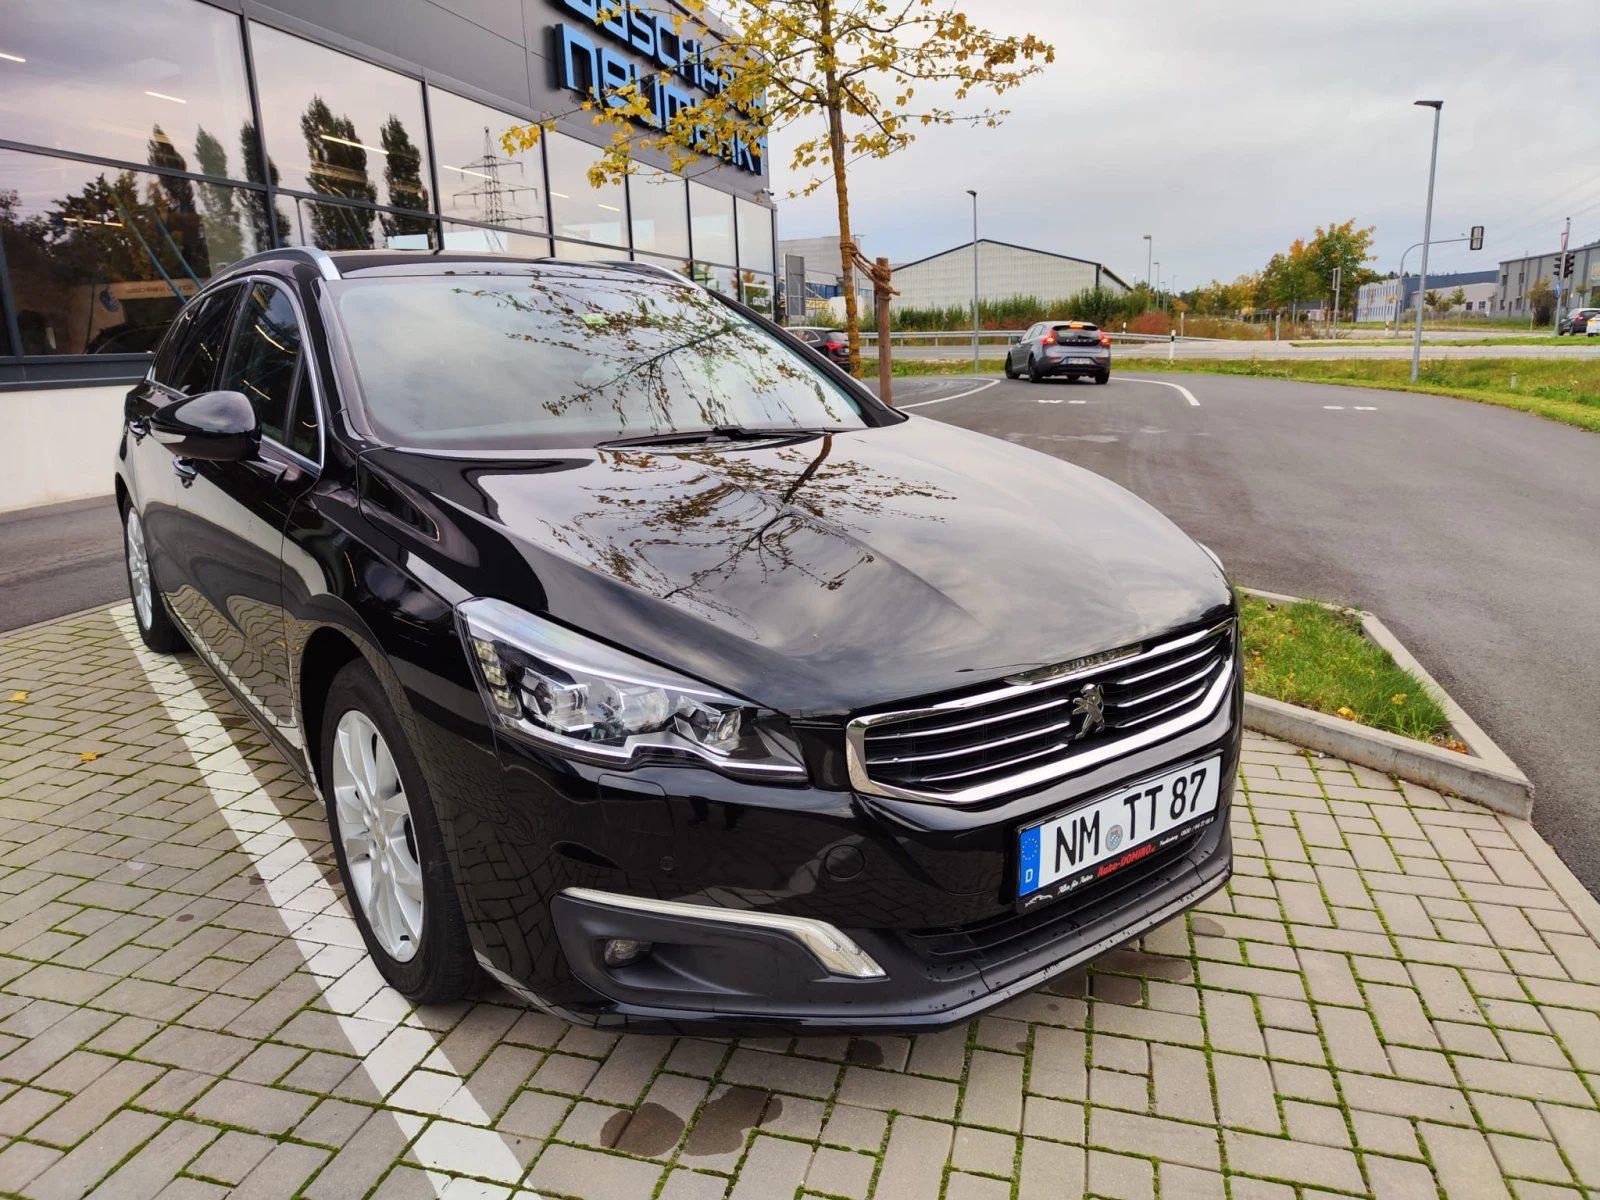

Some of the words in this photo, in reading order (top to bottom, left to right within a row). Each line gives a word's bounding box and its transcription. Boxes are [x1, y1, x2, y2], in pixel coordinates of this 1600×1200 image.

[1054, 810, 1100, 873] NM
[1123, 785, 1164, 840] TT
[1169, 767, 1207, 820] 87
[1025, 868, 1033, 883] D
